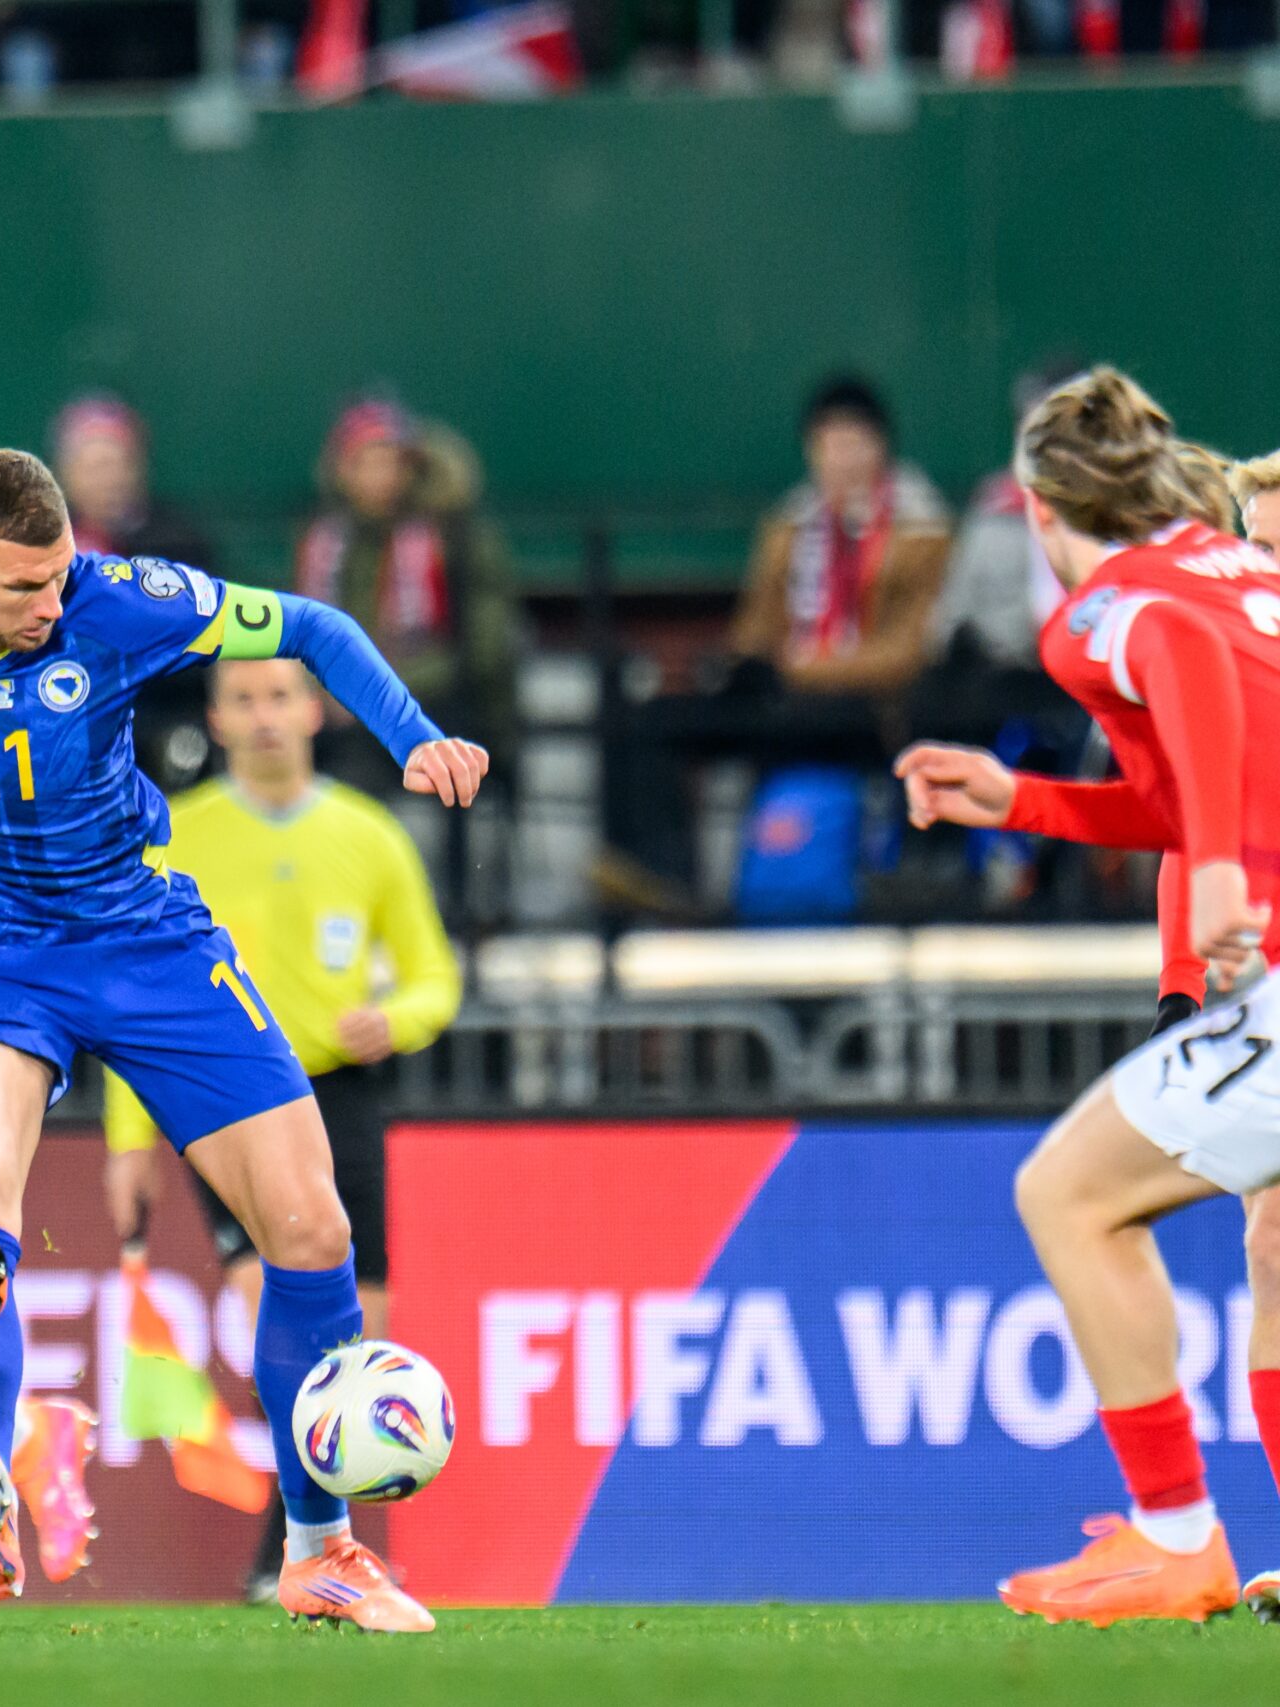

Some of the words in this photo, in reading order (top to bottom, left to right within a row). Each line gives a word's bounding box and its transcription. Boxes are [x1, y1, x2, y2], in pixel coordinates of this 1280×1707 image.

[235, 603, 272, 631] C
[209, 955, 268, 1032] 1
[1178, 1004, 1274, 1103] 21
[479, 1289, 825, 1447] FIFA
